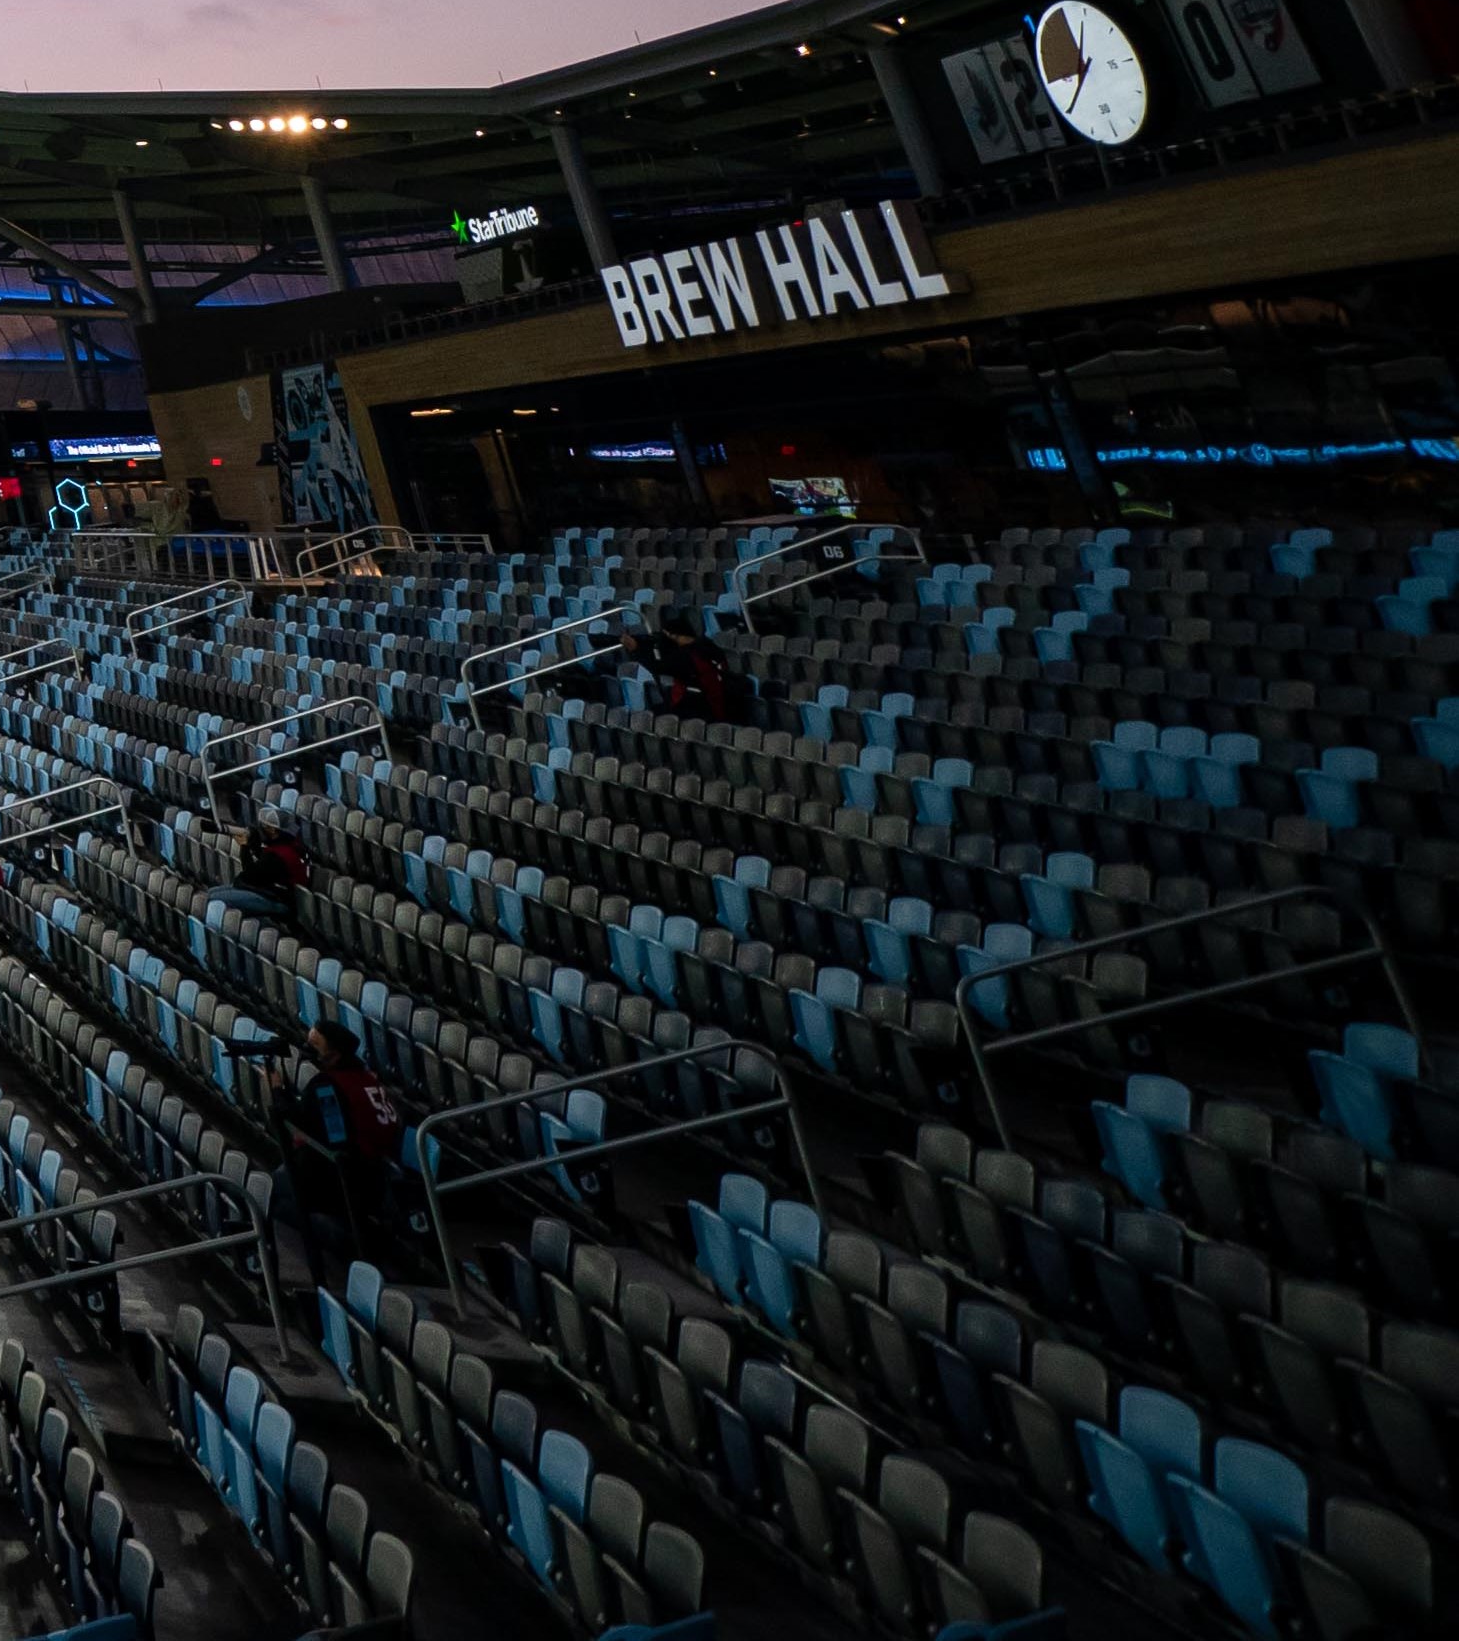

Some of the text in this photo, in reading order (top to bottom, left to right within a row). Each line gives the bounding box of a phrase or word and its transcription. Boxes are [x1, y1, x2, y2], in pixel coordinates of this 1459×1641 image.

[468, 206, 539, 243] StarTribune
[601, 200, 950, 348] BREW HALL
